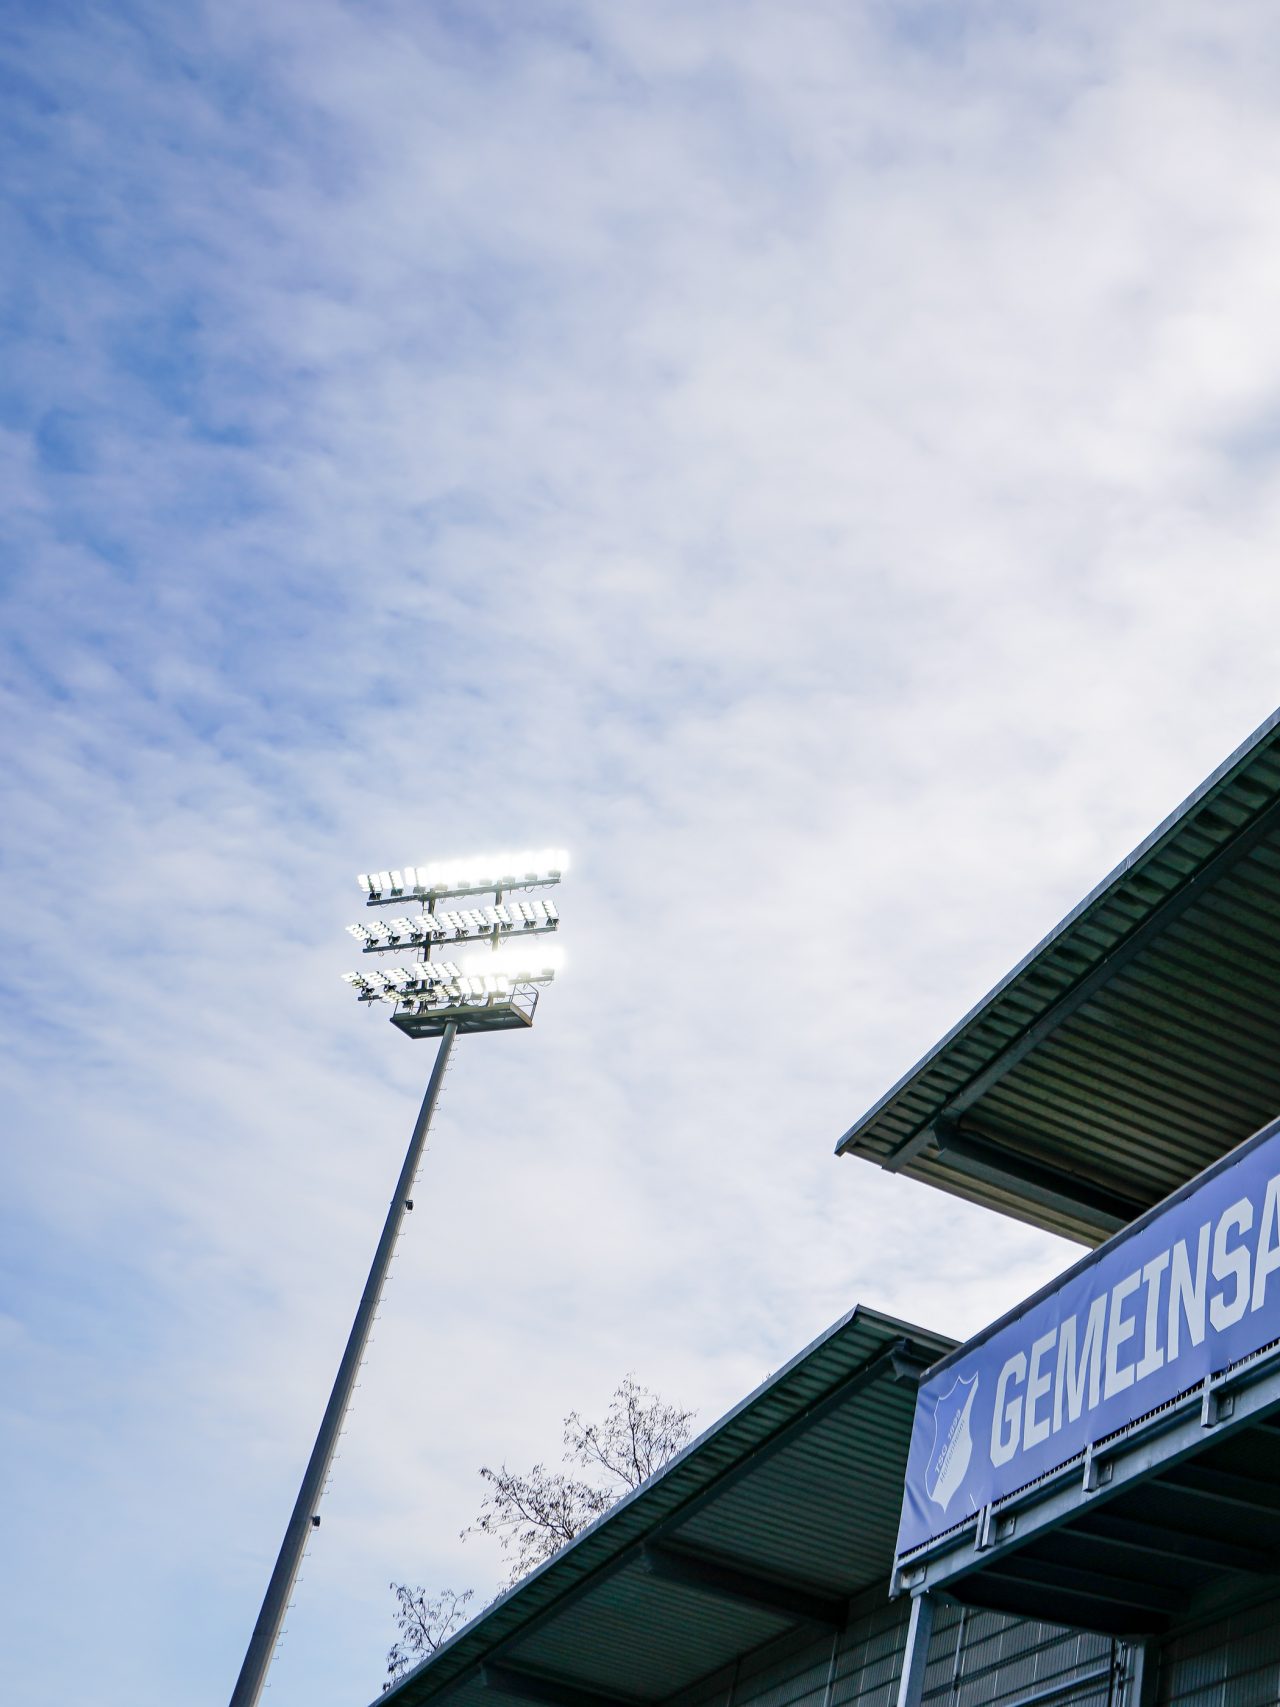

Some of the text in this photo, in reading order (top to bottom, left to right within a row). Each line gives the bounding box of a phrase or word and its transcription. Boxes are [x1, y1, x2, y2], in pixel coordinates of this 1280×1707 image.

[935, 1409, 961, 1474] TSG 1899
[940, 1419, 966, 1483] Hoffenheim
